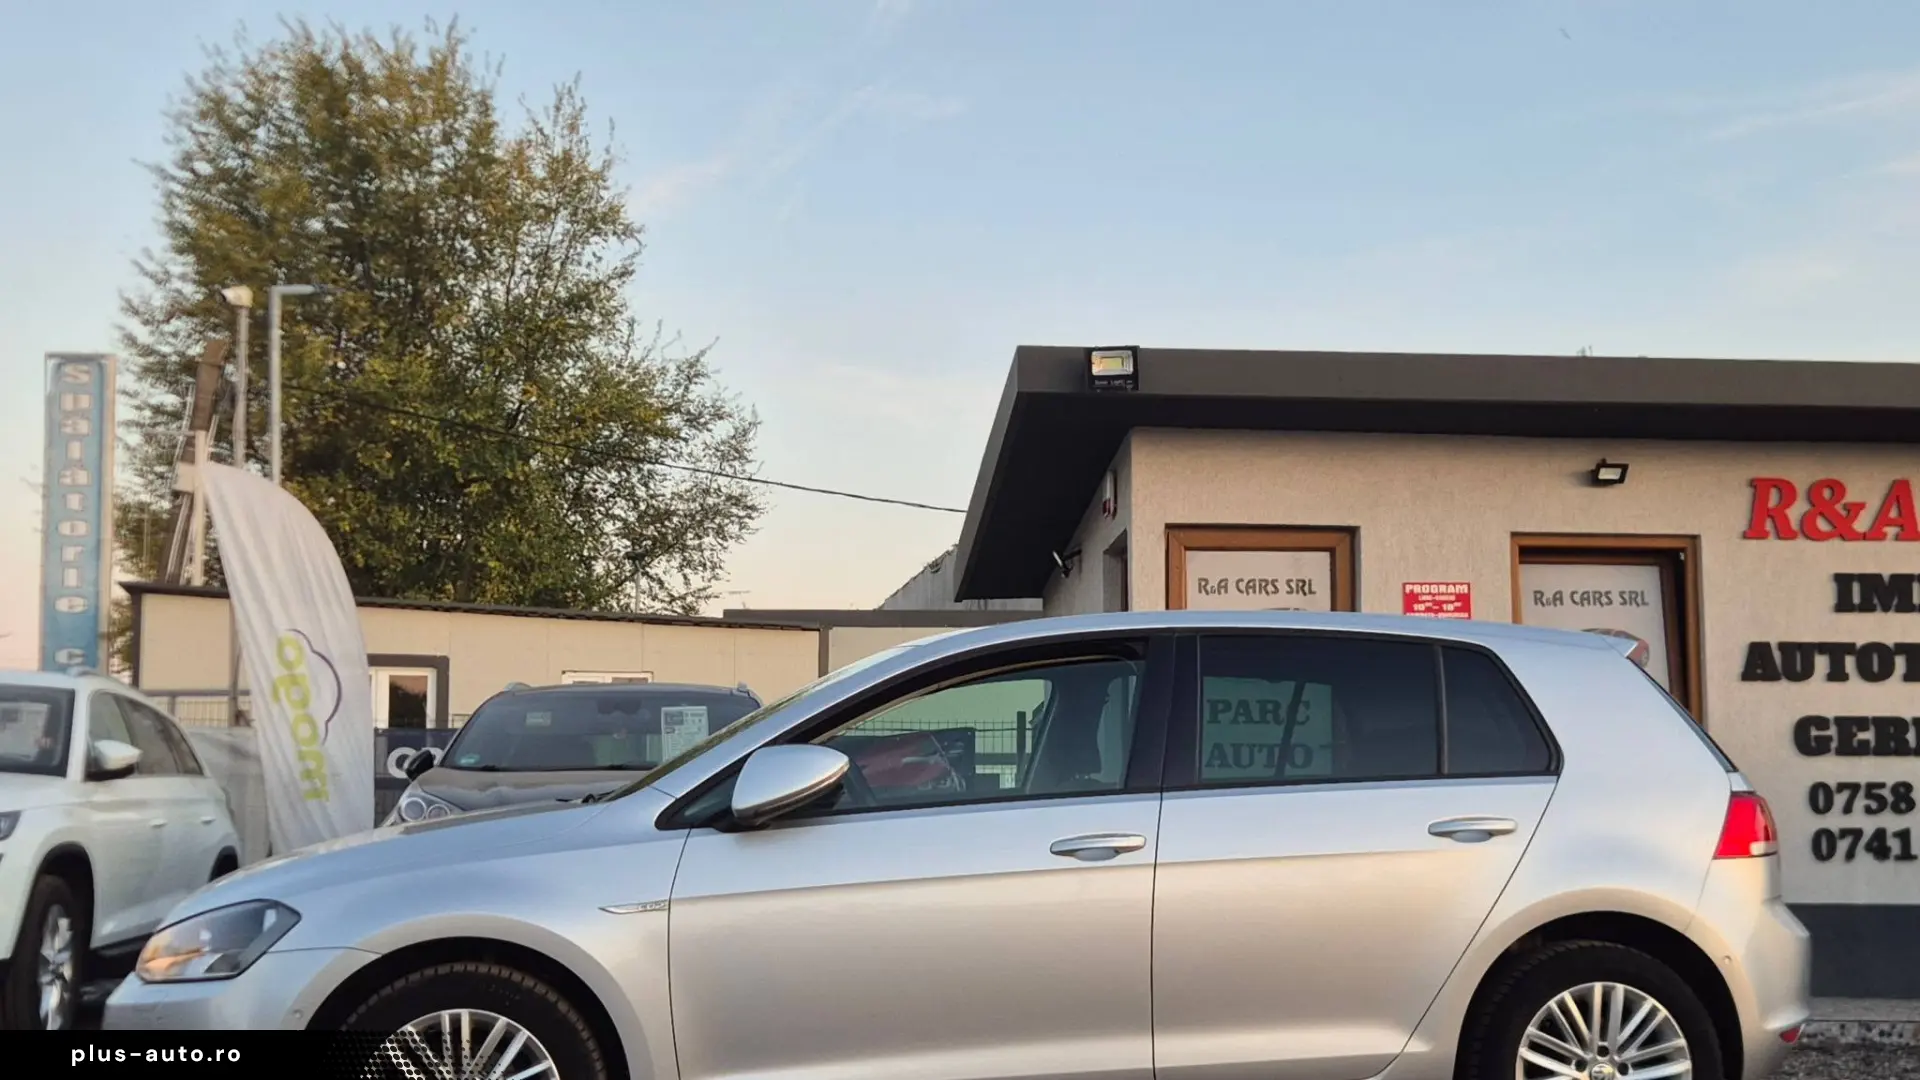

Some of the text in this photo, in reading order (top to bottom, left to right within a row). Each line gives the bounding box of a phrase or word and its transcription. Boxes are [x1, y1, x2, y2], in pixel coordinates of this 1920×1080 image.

[1198, 578, 1317, 596] R&A CARS SRL
[1405, 584, 1469, 594] PROGRAM
[1533, 590, 1650, 607] R&A CARS SRL
[1833, 572, 1920, 613] IM
[1794, 715, 1920, 757] GER
[1204, 743, 1315, 769] AUTO
[1808, 781, 1916, 816] 0758
[1811, 827, 1918, 862] 0741
